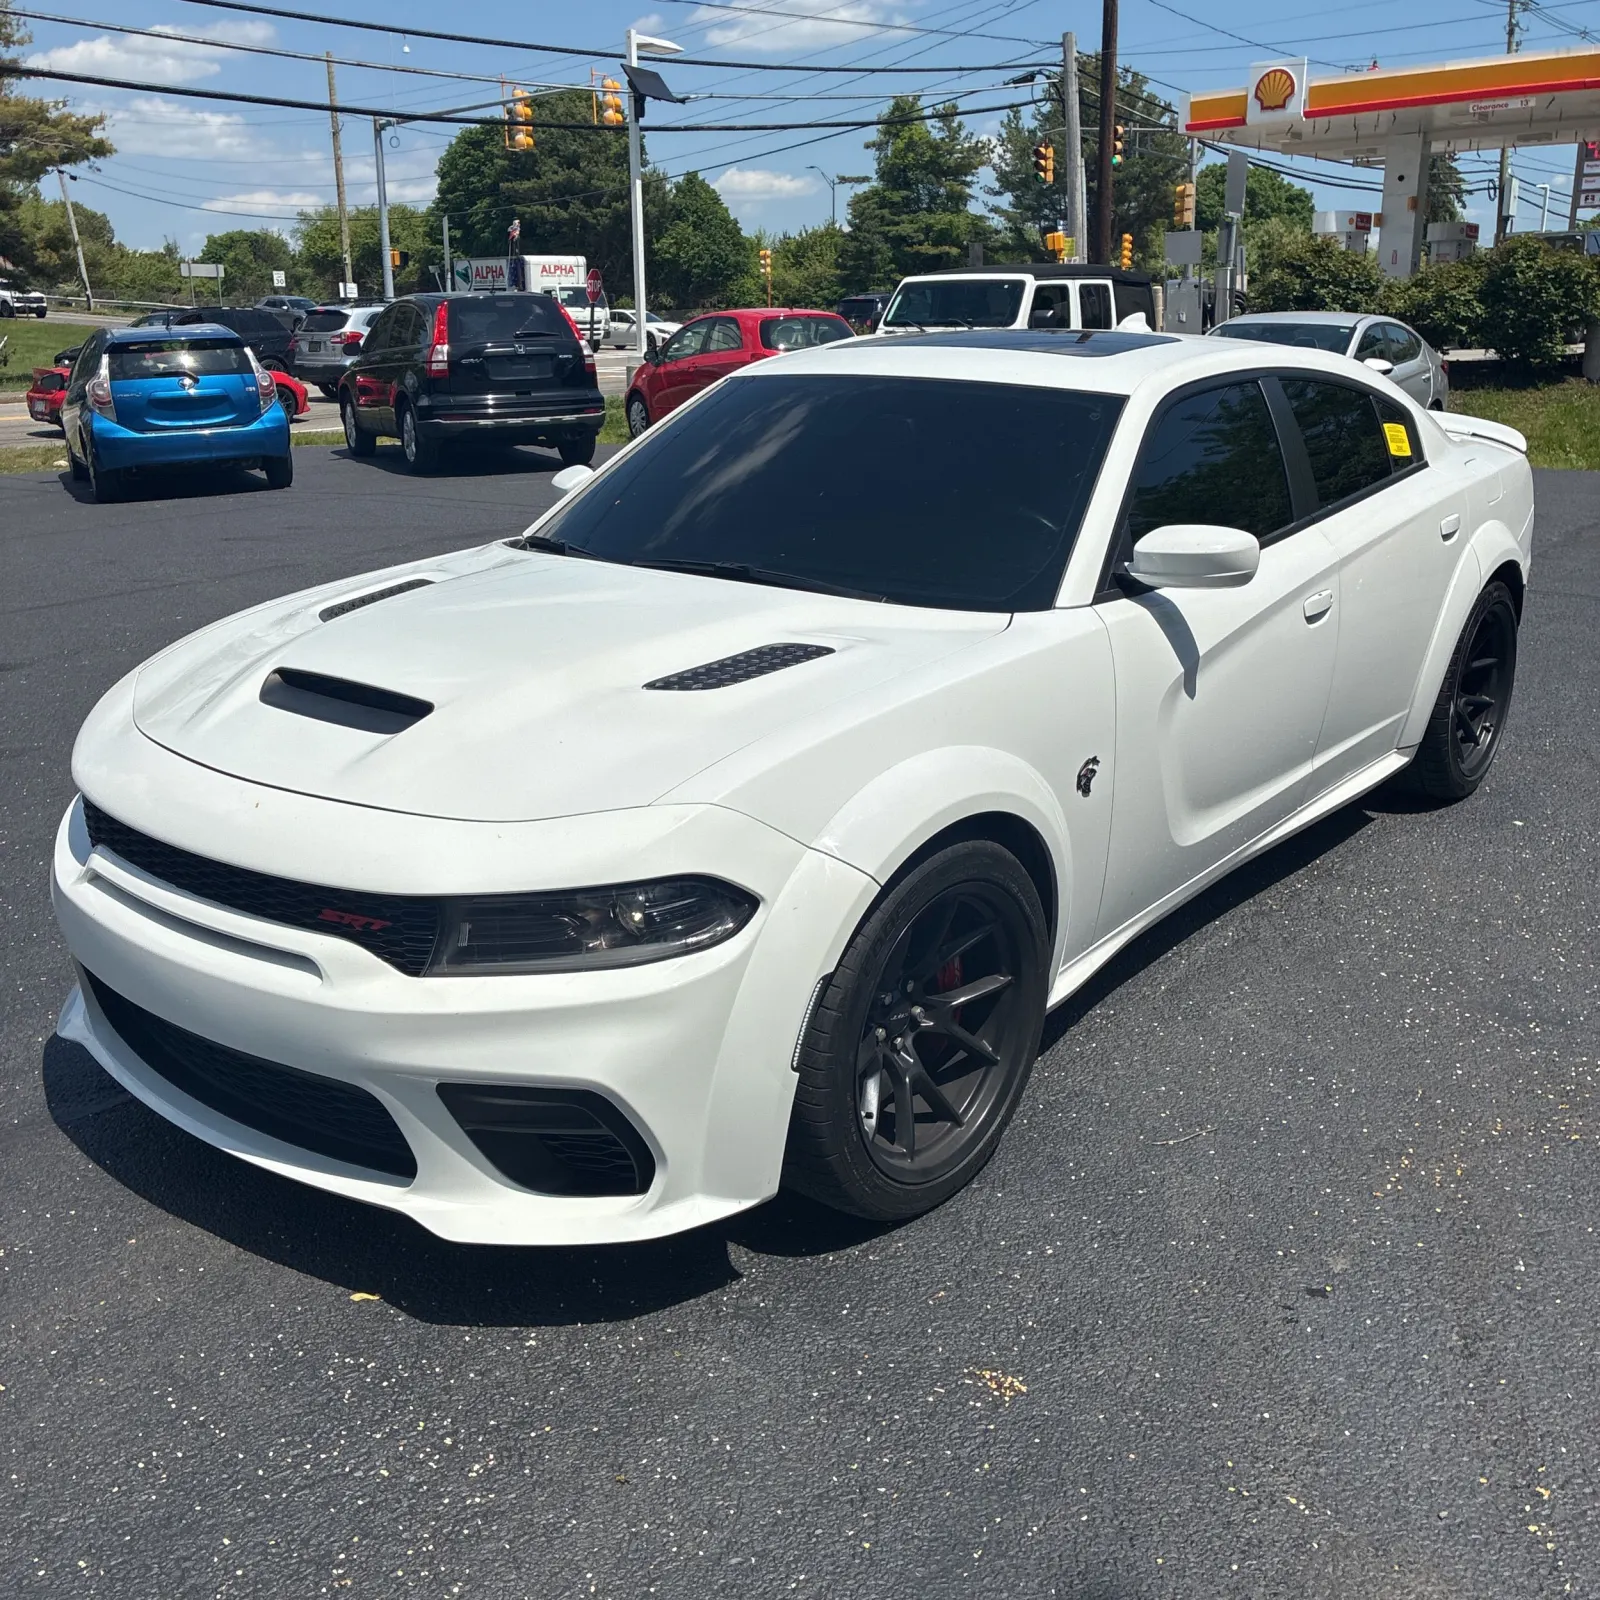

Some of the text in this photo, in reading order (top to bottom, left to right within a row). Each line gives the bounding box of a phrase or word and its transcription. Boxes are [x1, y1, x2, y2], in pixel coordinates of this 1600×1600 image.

[1471, 102, 1509, 112] Clearance
[474, 264, 505, 280] ALPHA
[540, 264, 575, 275] ALPHA
[587, 279, 601, 293] STOP
[317, 908, 393, 931] SRT
